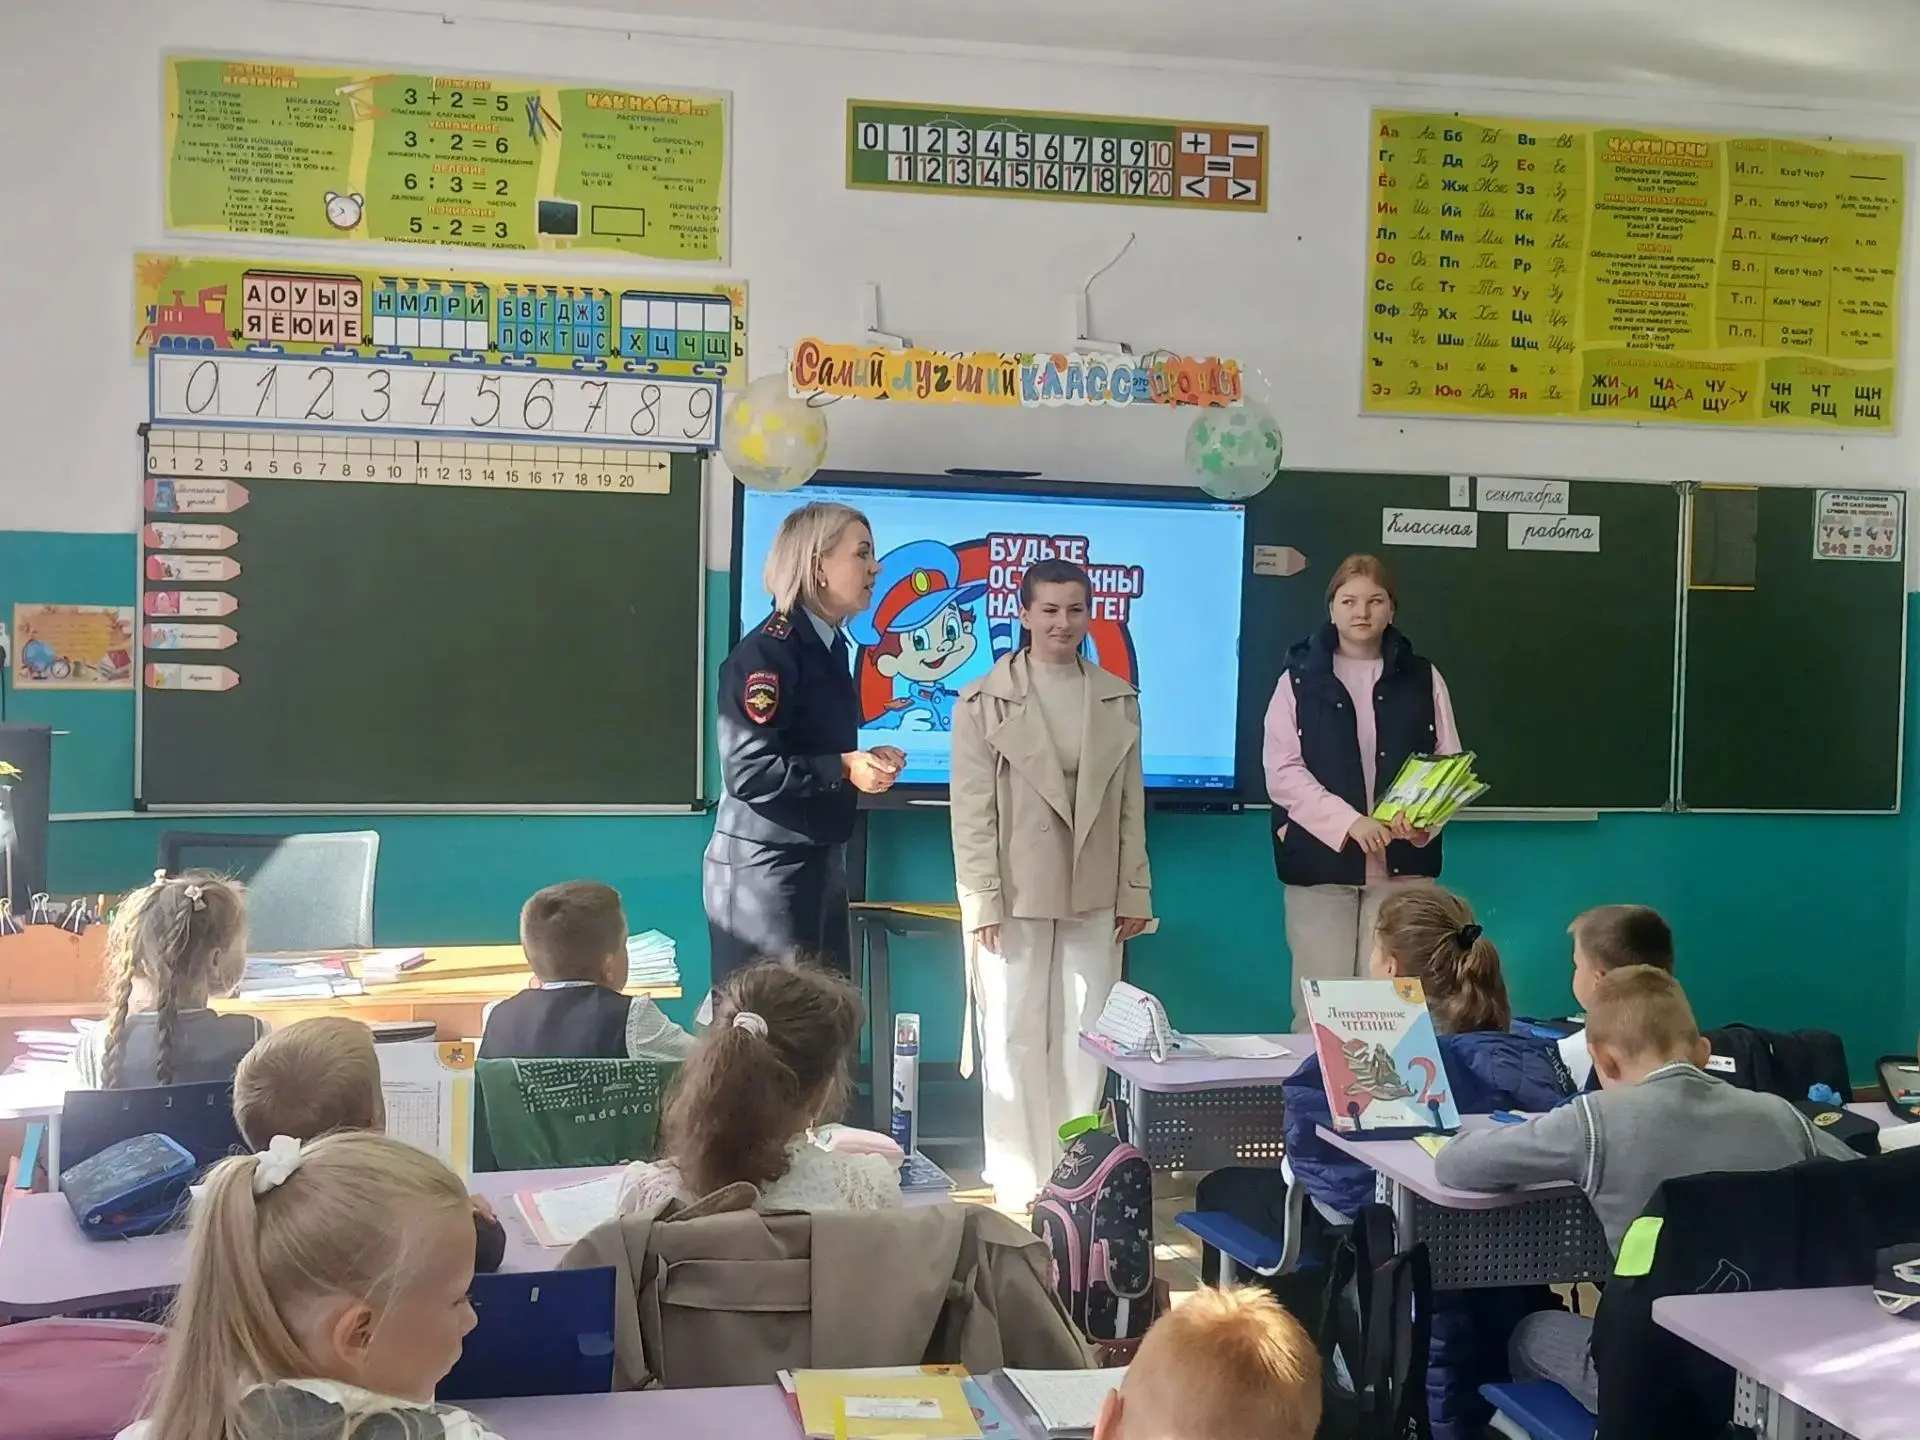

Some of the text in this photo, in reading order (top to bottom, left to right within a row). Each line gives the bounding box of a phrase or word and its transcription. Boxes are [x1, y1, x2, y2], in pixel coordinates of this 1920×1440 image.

[405, 88, 508, 111] 3 2 5
[586, 91, 625, 110] КАК
[405, 131, 508, 154] 3 2 6
[863, 123, 1172, 167] 0 1 2 3 4 5 6 7 8 9 10
[1380, 124, 1536, 146] Аа Бб Вв
[1442, 154, 1464, 168] Дд
[1735, 161, 1764, 175] И.п.
[404, 173, 508, 196] 6 3 2
[894, 155, 1172, 196] 11 12 13 14 15 16 17 18 19 20
[1441, 179, 1536, 195] Жж Зз
[1734, 194, 1762, 208] Р.п.
[1378, 203, 1533, 221] Ии Кк
[410, 217, 508, 239] 5 2 3
[1376, 227, 1535, 247] Лл Мм Нн
[1732, 227, 1762, 241] Д.п.
[1376, 252, 1532, 273] Оо Пп Рр
[1732, 260, 1760, 272] В.п.
[1375, 278, 1394, 292] Сс
[246, 285, 262, 303] А
[294, 287, 308, 307] У
[317, 288, 337, 306] Ы
[343, 290, 359, 307] Э
[1731, 292, 1757, 305] Т.п.
[247, 312, 357, 338] Я Ё Ю И Е
[1438, 307, 1533, 324] Хх Цц
[1437, 333, 1540, 351] Шш Щщ
[1021, 361, 1133, 403] КЛАСС
[1435, 385, 1528, 400] Юю Яя
[1592, 374, 1726, 393] ЖИ ЧА ЧУ
[1770, 382, 1882, 402] ЧН ЧТ ЩН
[185, 360, 713, 439] 0 1 2 3 4 5 6 7 8 9
[1591, 393, 1730, 414] ШИ ЩА ЩУ
[1627, 386, 1748, 402] И А У
[1770, 400, 1881, 421] ЧК РЩ НЩ
[387, 464, 635, 489] 10 11 12 14 16 18 20
[1485, 482, 1564, 511] сентября
[1387, 512, 1594, 546] Классная работа
[990, 537, 1084, 565] БУДЬТЕ
[989, 565, 1139, 594] ОСТЖНЫ
[988, 592, 1019, 617] НА
[1327, 1007, 1407, 1023] Литературное
[1341, 1020, 1398, 1032] ЧТЕНИЕ
[1408, 1057, 1446, 1105] 2
[575, 1103, 659, 1124] made 4YO
